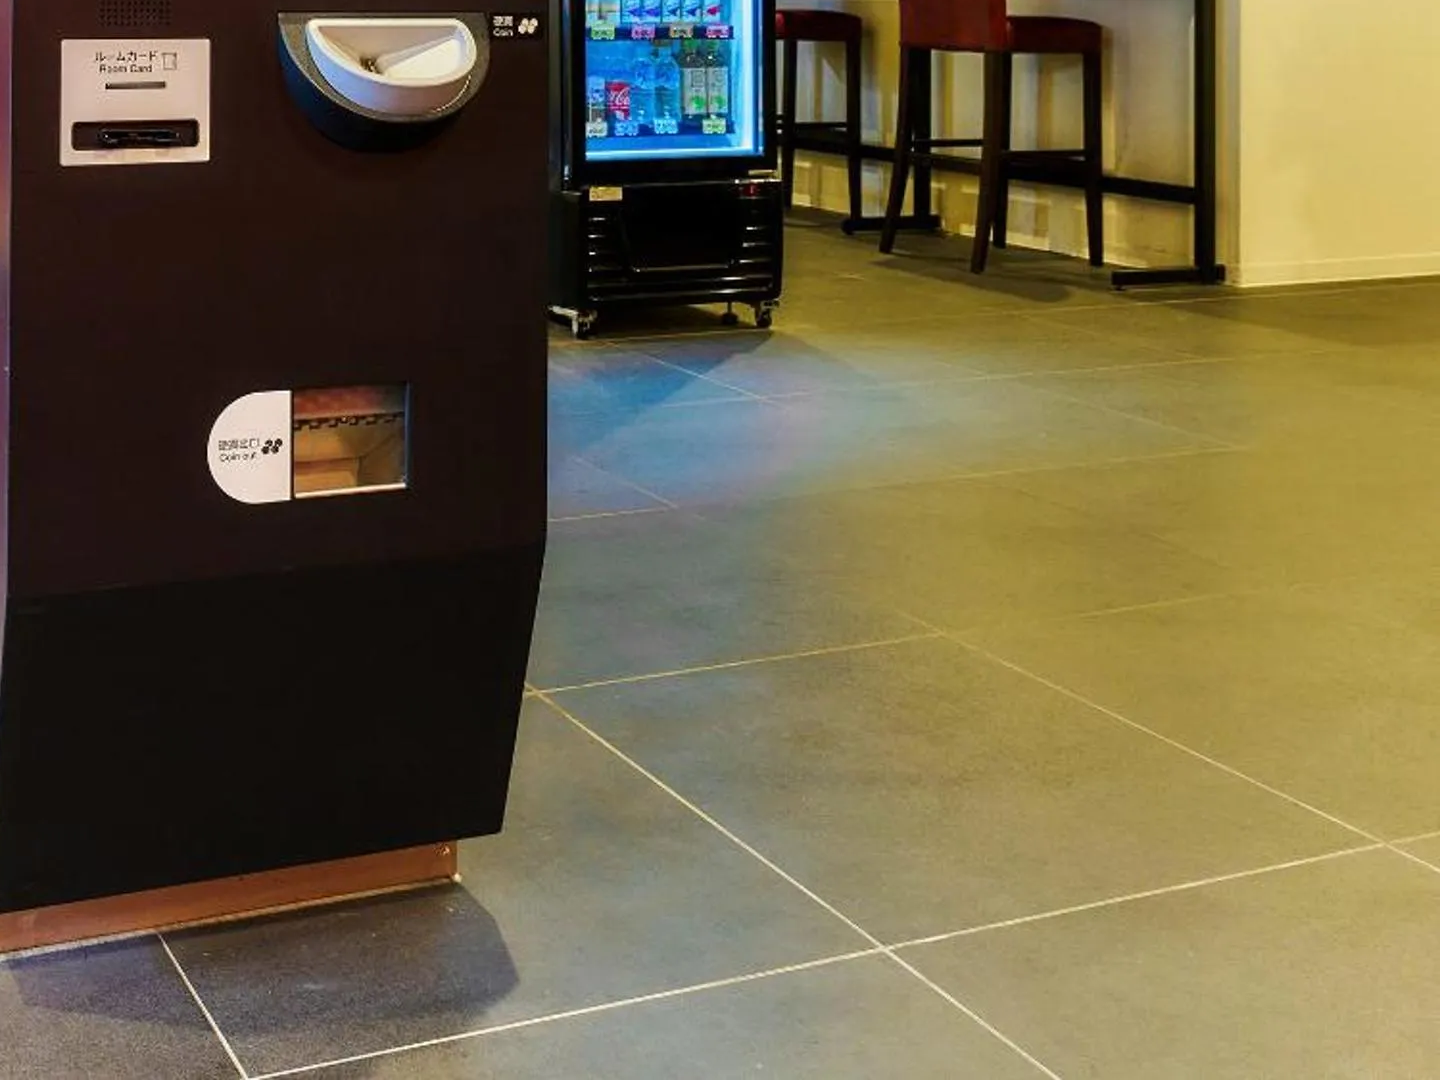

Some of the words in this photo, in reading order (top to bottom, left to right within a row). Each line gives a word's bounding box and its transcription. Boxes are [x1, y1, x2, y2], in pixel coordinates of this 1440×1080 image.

[95, 50, 158, 61] ルームカード
[130, 63, 153, 73] Card
